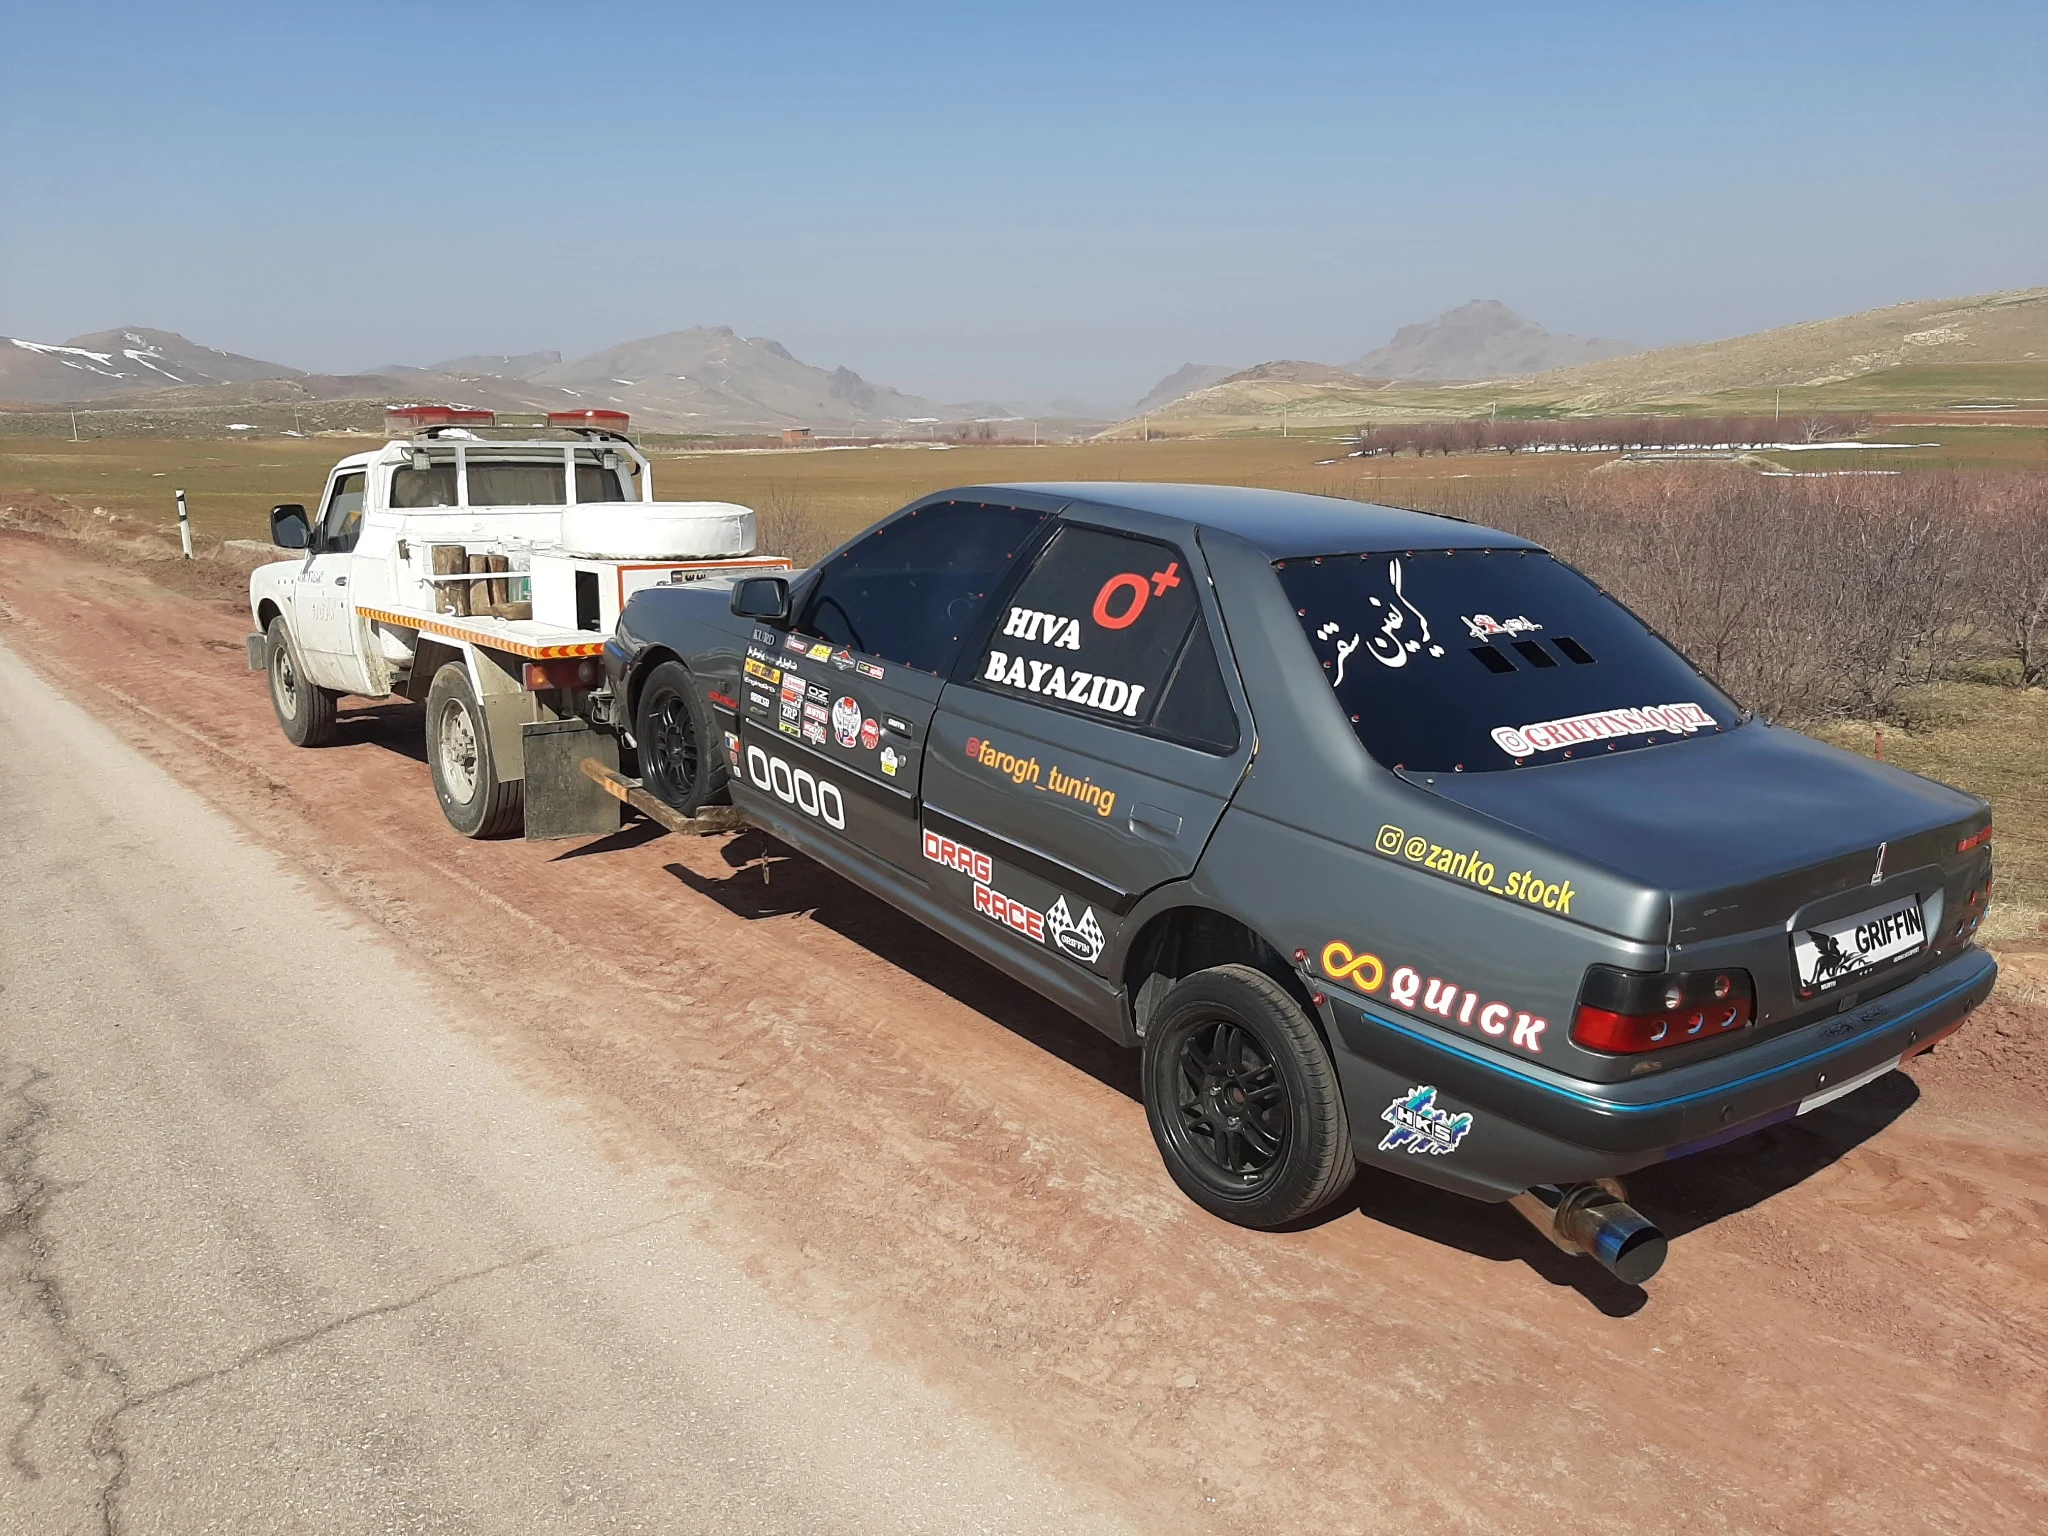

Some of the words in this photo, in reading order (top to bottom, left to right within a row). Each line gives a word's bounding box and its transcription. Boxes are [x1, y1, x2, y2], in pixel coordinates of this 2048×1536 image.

[753, 629, 775, 646] KURD
[1002, 606, 1081, 650] HIVA
[808, 685, 829, 700] OZ
[984, 650, 1146, 717] BAYAZIDI
[923, 828, 993, 885] DRAG
[1404, 836, 1576, 915] @zanko_stock
[973, 880, 1045, 943] RACE
[1855, 906, 1921, 954] GRIFFIN
[1061, 934, 1091, 954] GRIFFIN
[1390, 966, 1548, 1053] QUICK
[1397, 1106, 1452, 1143] HKS
